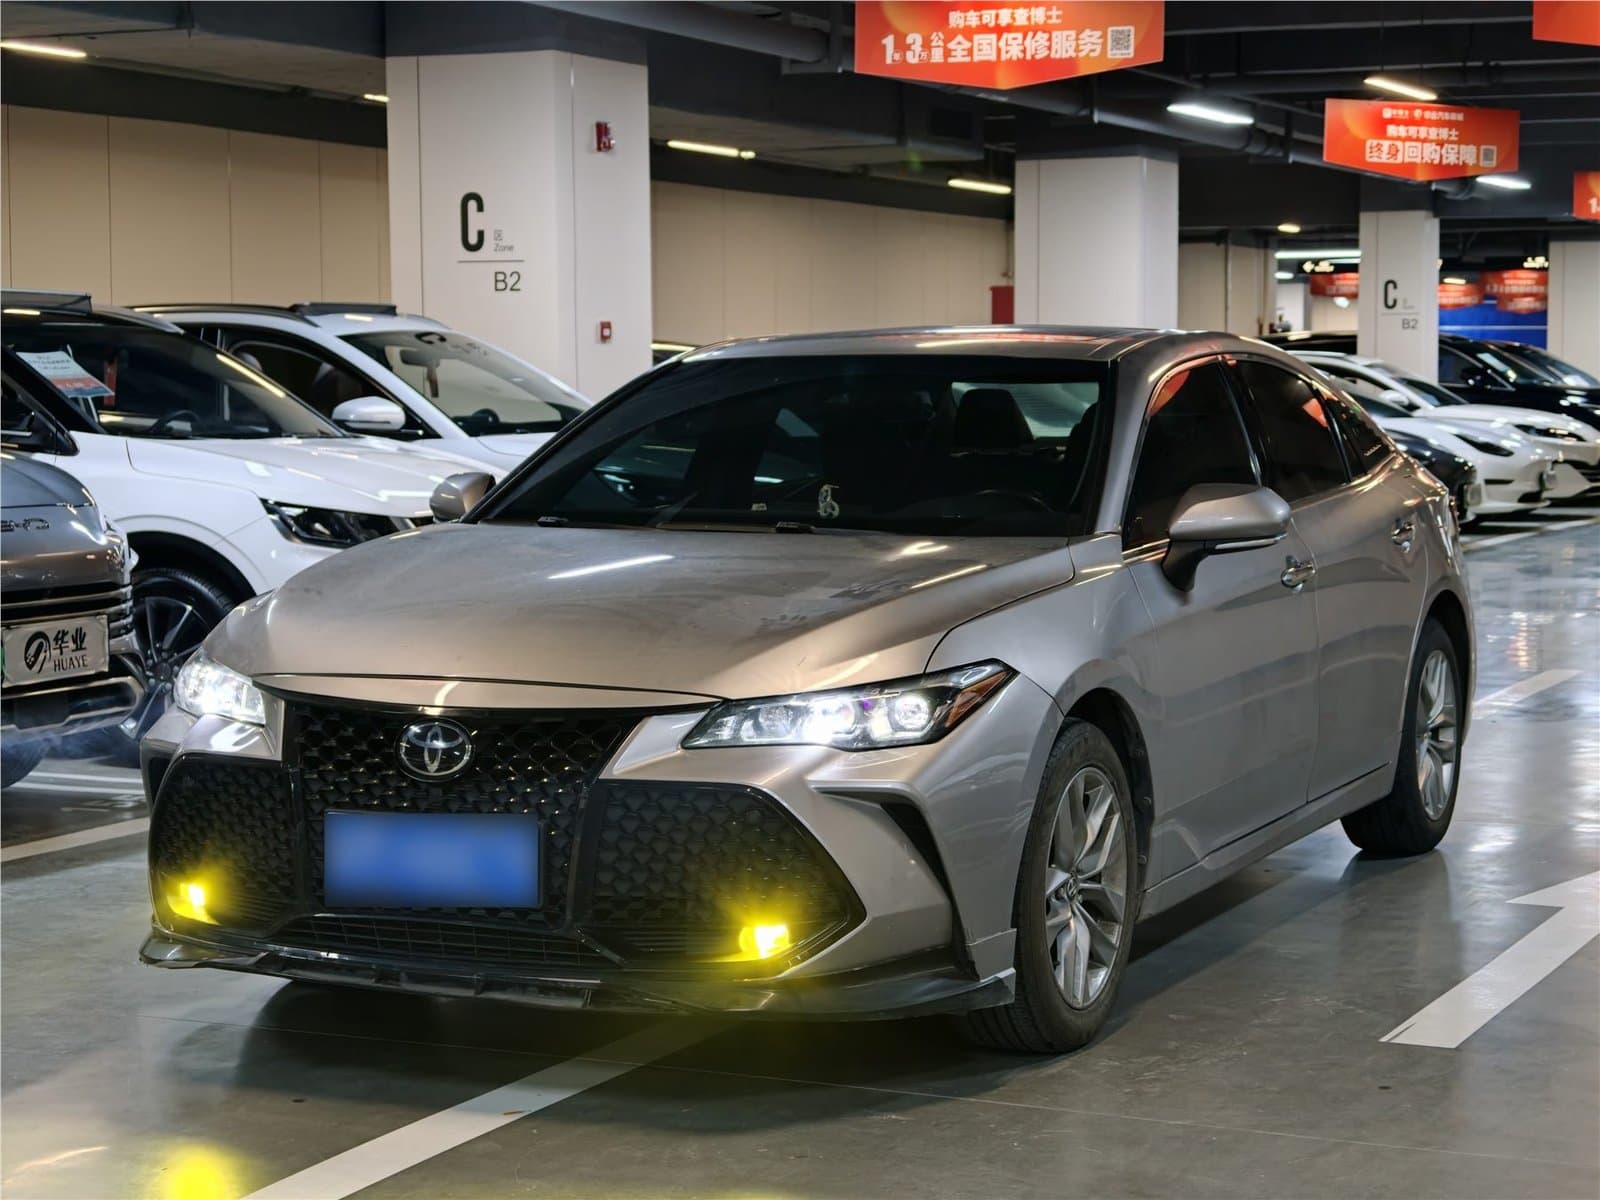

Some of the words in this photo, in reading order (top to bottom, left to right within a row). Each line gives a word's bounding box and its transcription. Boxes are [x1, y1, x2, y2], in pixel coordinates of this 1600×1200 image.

[948, 6, 1063, 28] 购车可享查博士
[1366, 141, 1477, 165] 终身回购保障
[461, 192, 485, 252] C
[494, 243, 514, 252] Zone
[494, 271, 521, 292] B2
[1384, 280, 1397, 309] C
[1402, 318, 1418, 329] B2
[52, 627, 87, 656] 华业
[53, 654, 88, 672] HUAYE
